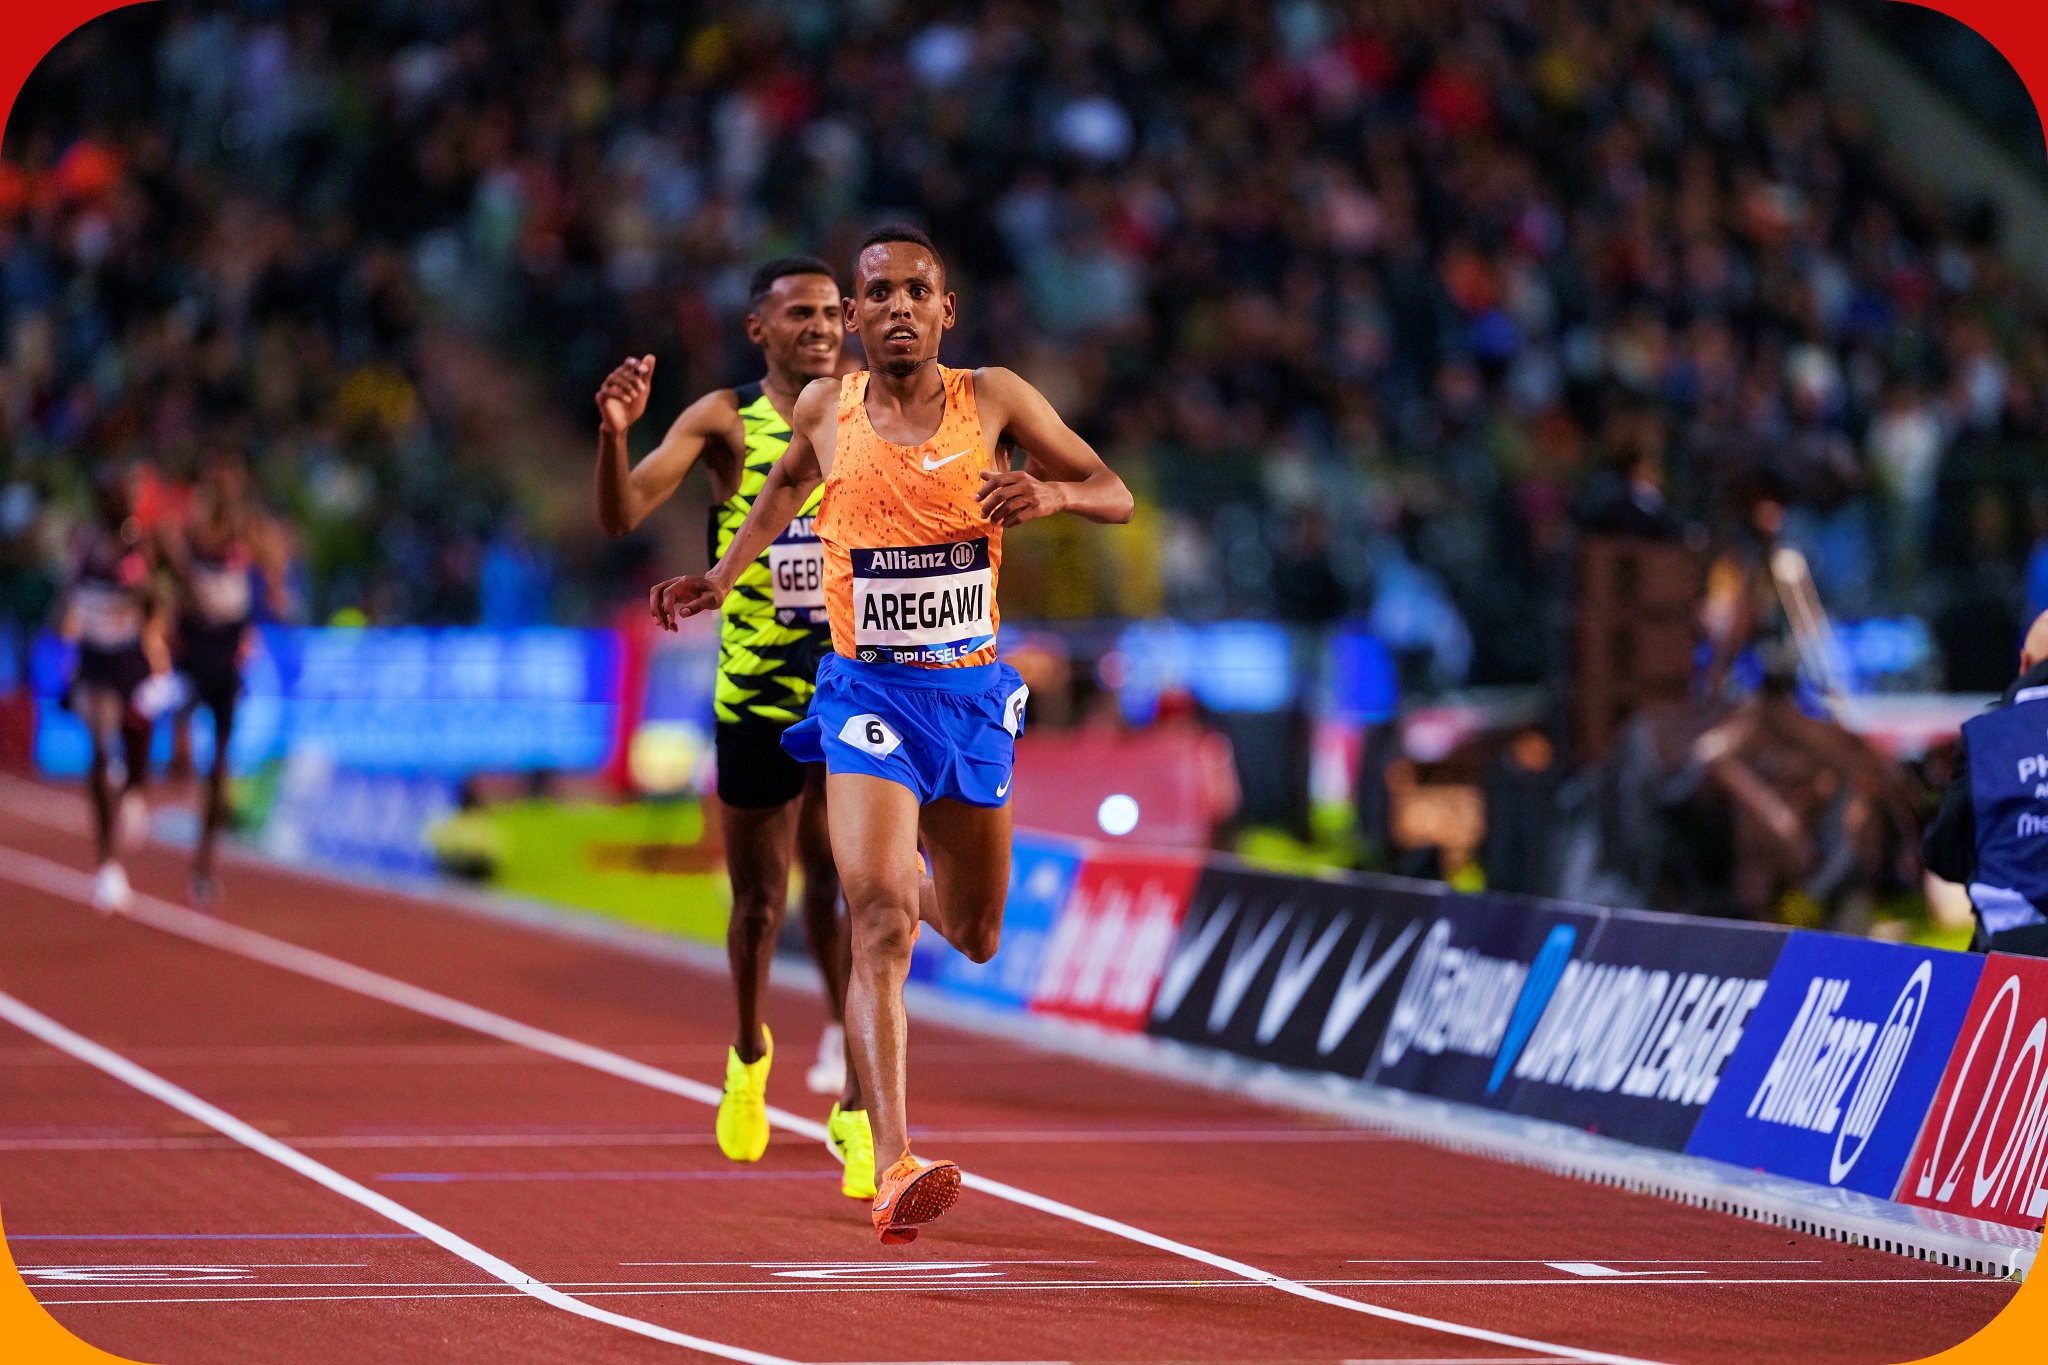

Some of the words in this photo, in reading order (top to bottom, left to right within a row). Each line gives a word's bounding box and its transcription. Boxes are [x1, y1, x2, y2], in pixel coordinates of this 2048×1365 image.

[778, 558, 825, 592] GEB
[871, 550, 947, 571] Allianz
[862, 583, 984, 631] AREGAWI
[894, 645, 969, 665] BRUSSELS
[866, 721, 885, 745] 6
[1514, 957, 1671, 1094] DIAMOND
[1620, 971, 1769, 1107] LEAGUE
[1746, 976, 1878, 1134] Allianz
